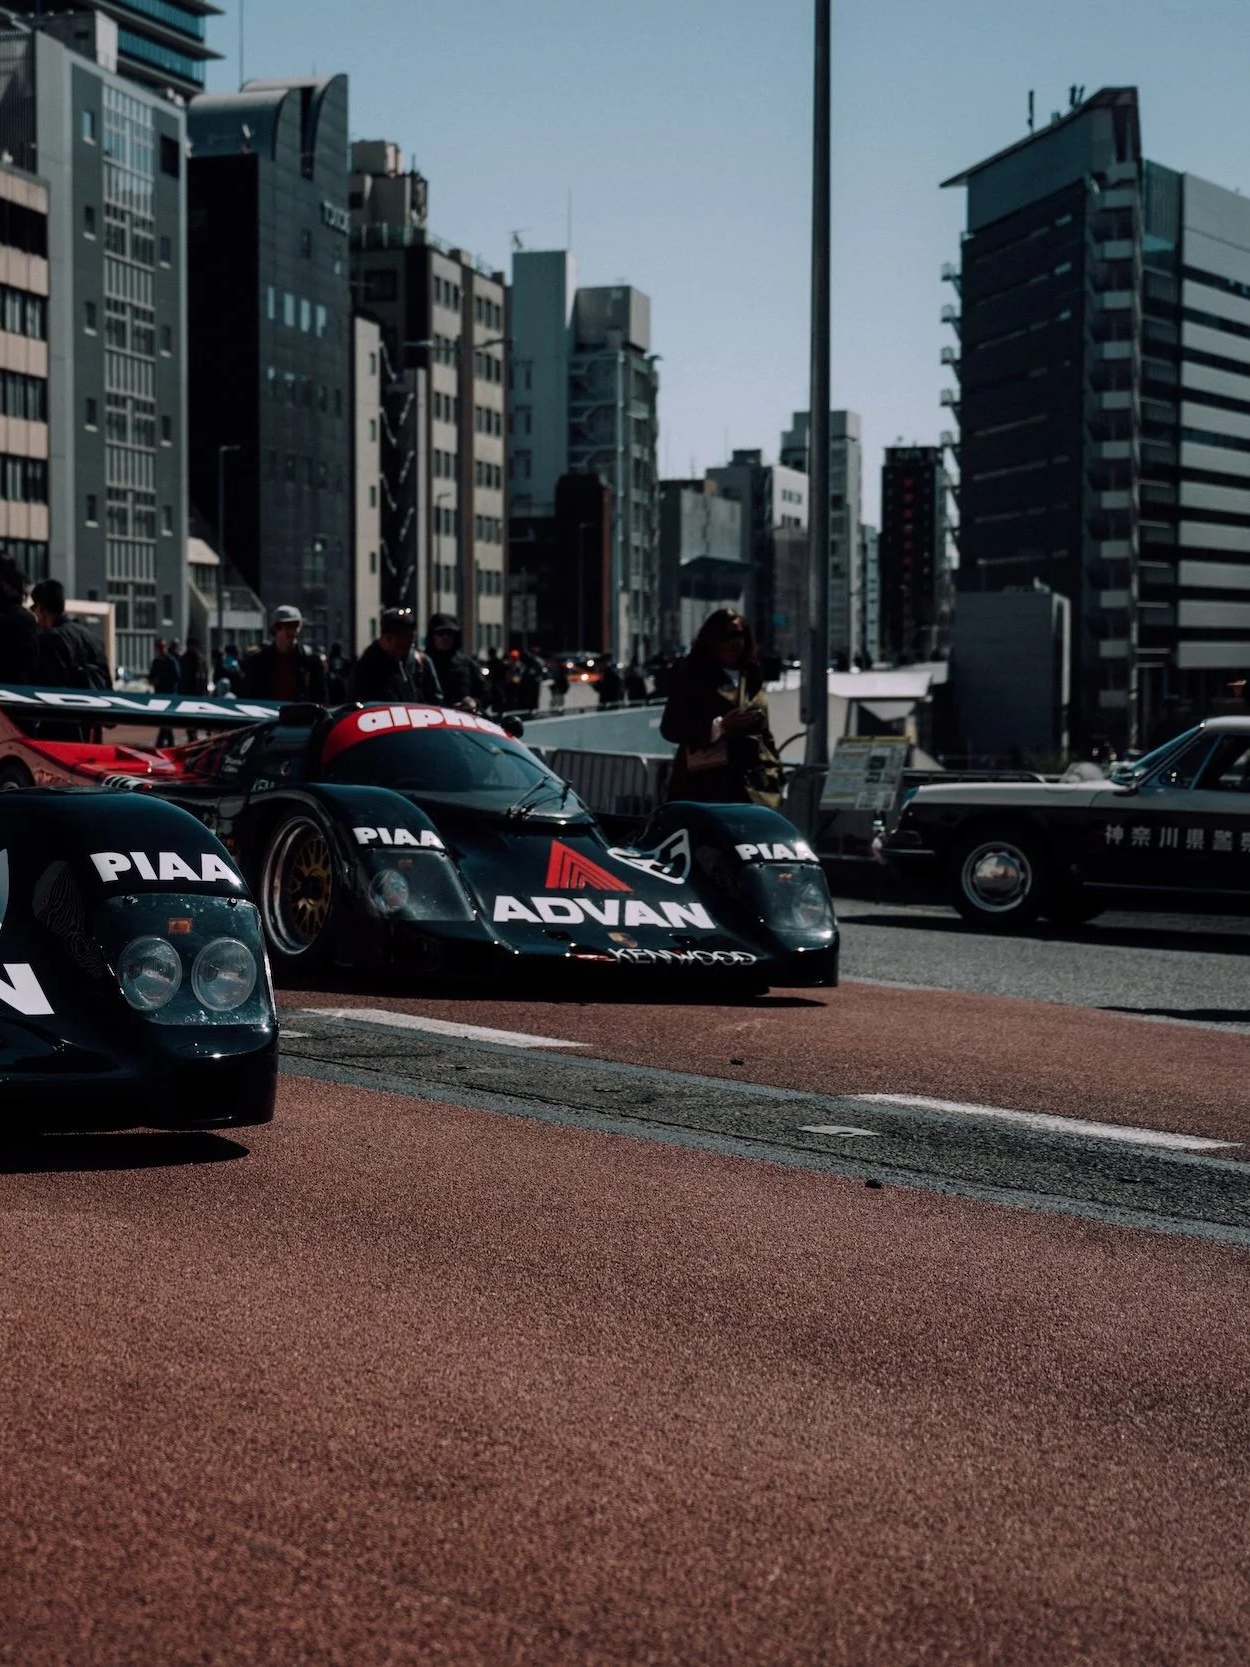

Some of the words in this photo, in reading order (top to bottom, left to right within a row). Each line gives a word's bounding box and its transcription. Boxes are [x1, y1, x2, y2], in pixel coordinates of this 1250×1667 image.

[356, 706, 509, 736] alpha
[352, 827, 445, 849] PIAA
[734, 842, 820, 862] PIAA
[90, 852, 242, 887] PIAA
[492, 895, 716, 929] ADVAN
[607, 947, 758, 966] KENWOOD
